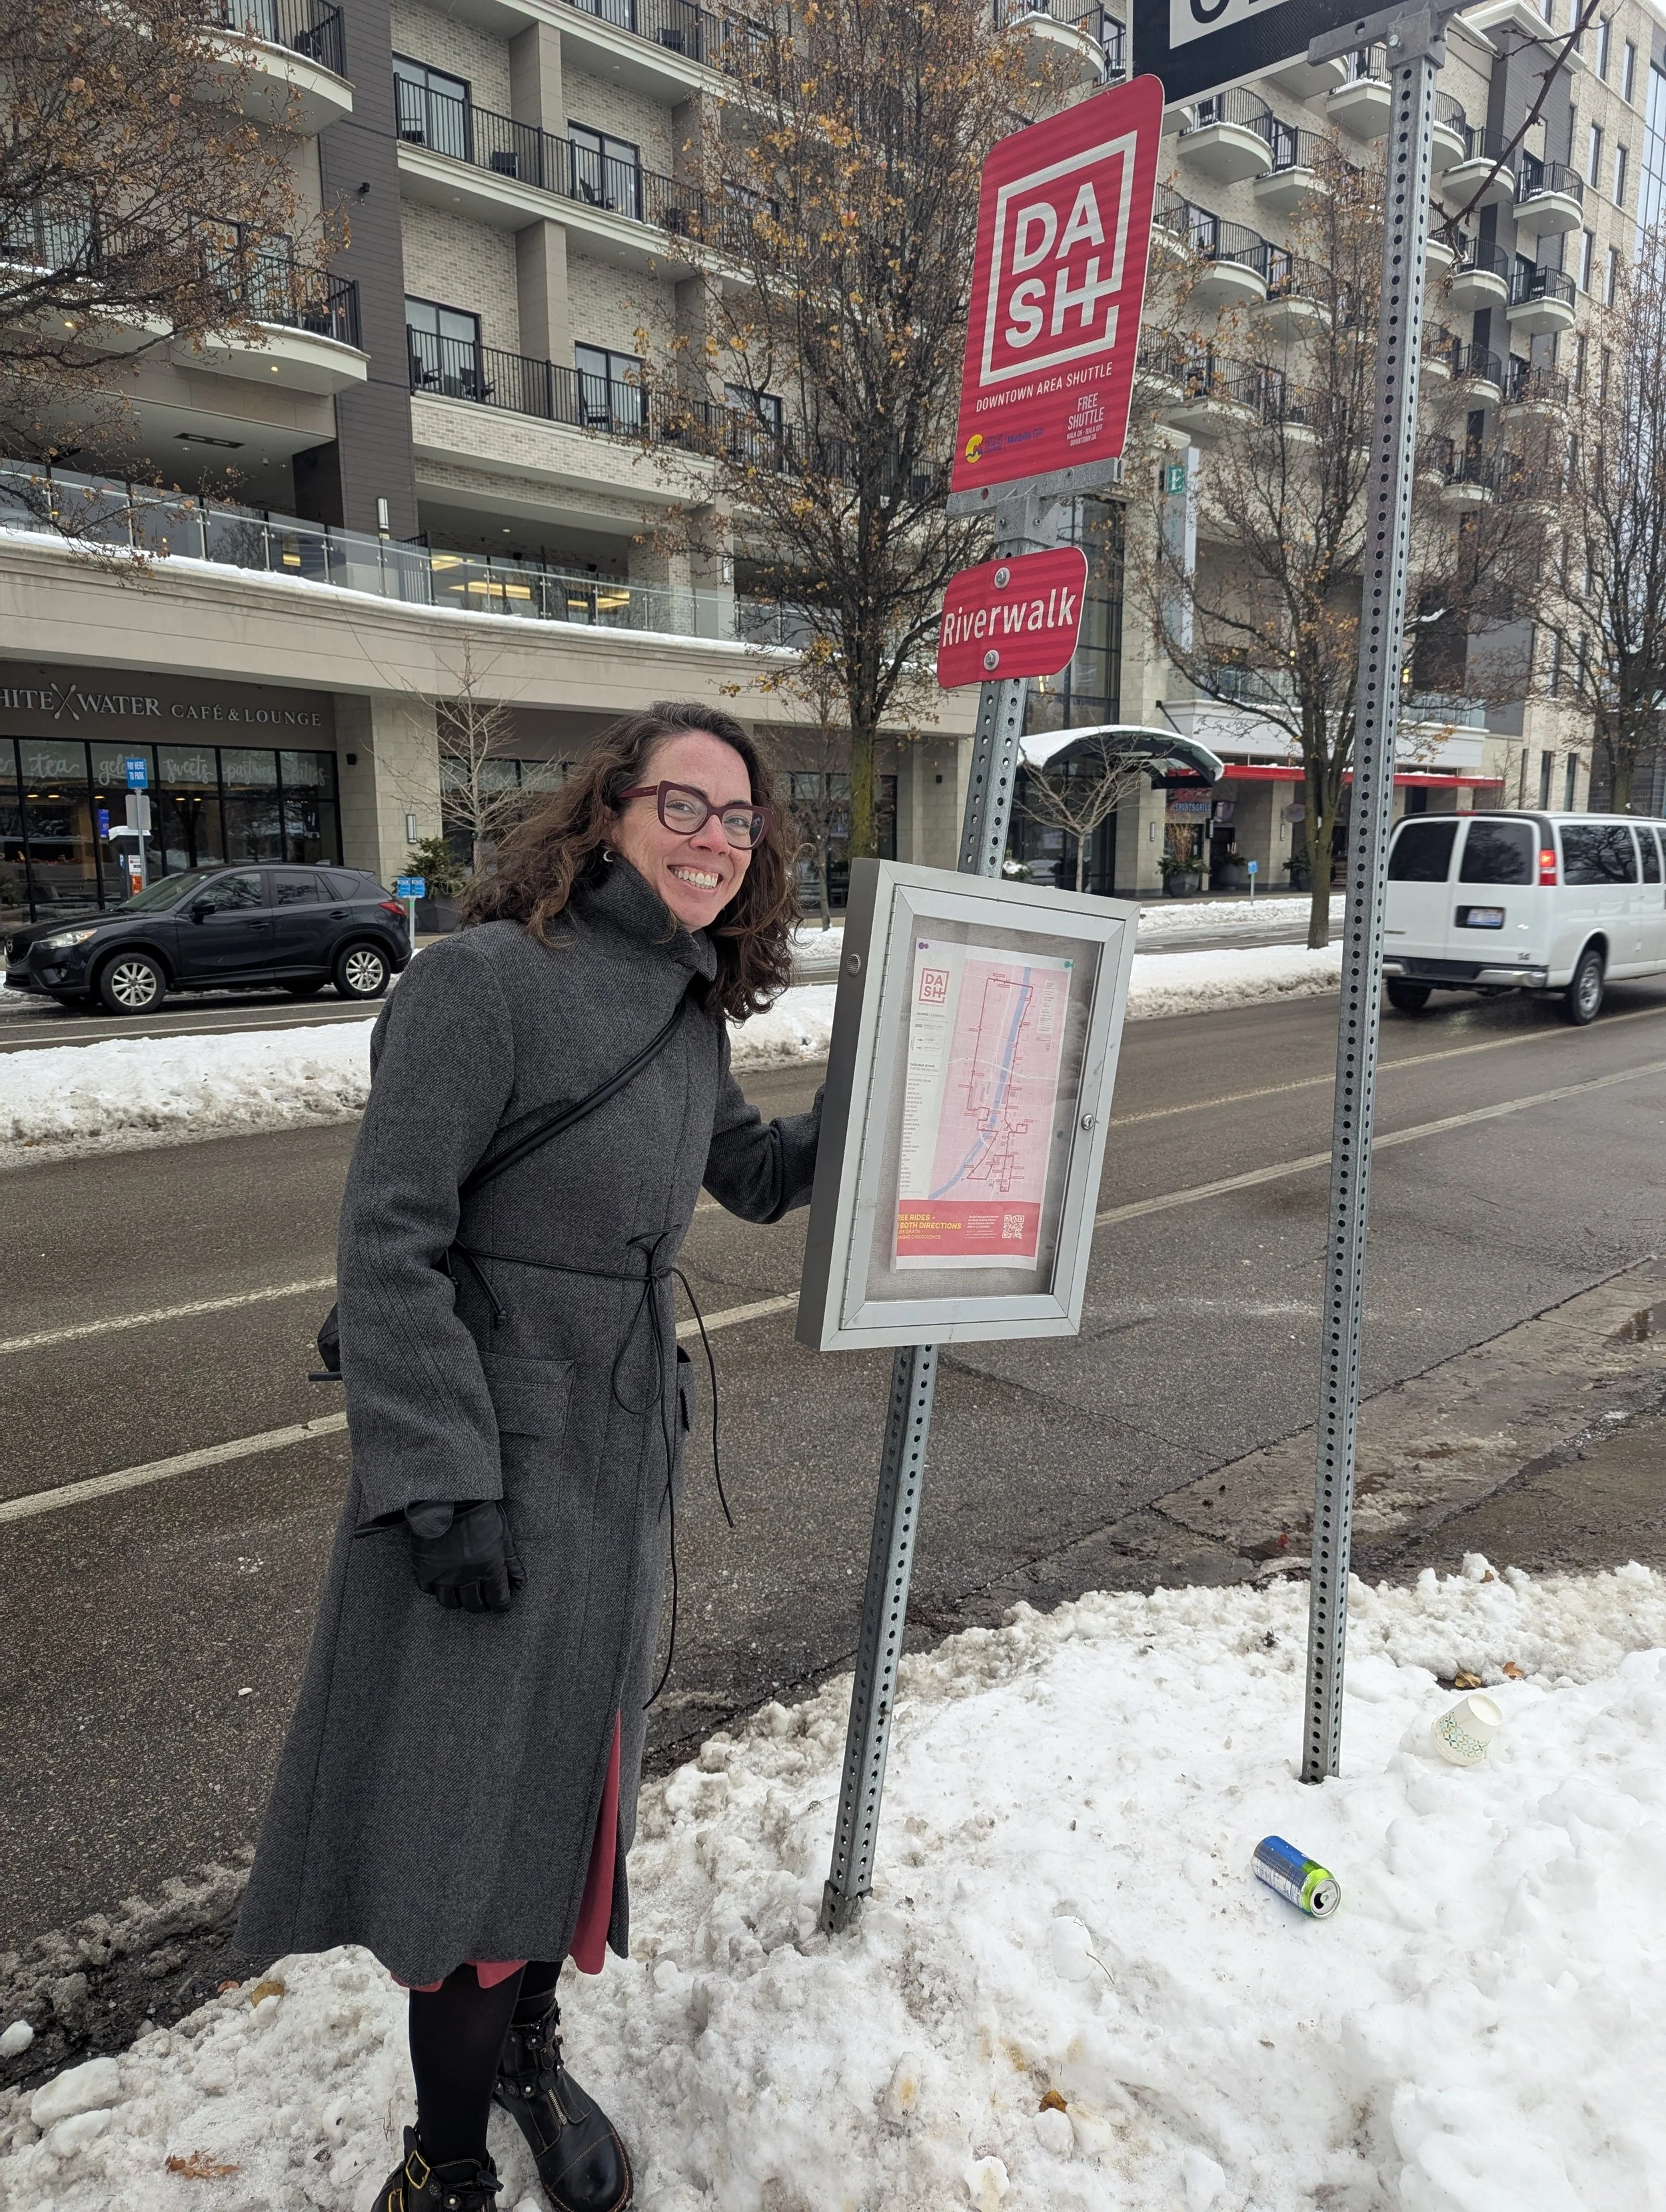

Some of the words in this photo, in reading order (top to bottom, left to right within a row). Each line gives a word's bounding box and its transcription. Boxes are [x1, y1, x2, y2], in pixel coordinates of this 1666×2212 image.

[976, 384, 1034, 412] DOWNTOWN
[1036, 376, 1062, 396] AREA
[1066, 362, 1113, 387] SHUTTLE
[1077, 392, 1098, 412] FREE
[1068, 406, 1105, 430] SHUTTLE
[1066, 431, 1077, 440] WALK
[1085, 426, 1096, 435] WALK
[1070, 434, 1092, 446] DOWNTOWN
[942, 586, 1077, 648] Riverwalk
[0, 688, 55, 710] HITE
[76, 693, 162, 716] WATER
[171, 704, 223, 721] CAFÉ
[228, 708, 241, 722] &
[245, 708, 323, 727] LOUNGE
[28, 752, 80, 779] tea
[98, 753, 137, 786] gel
[162, 754, 214, 784] sweets
[135, 771, 145, 780] PARK
